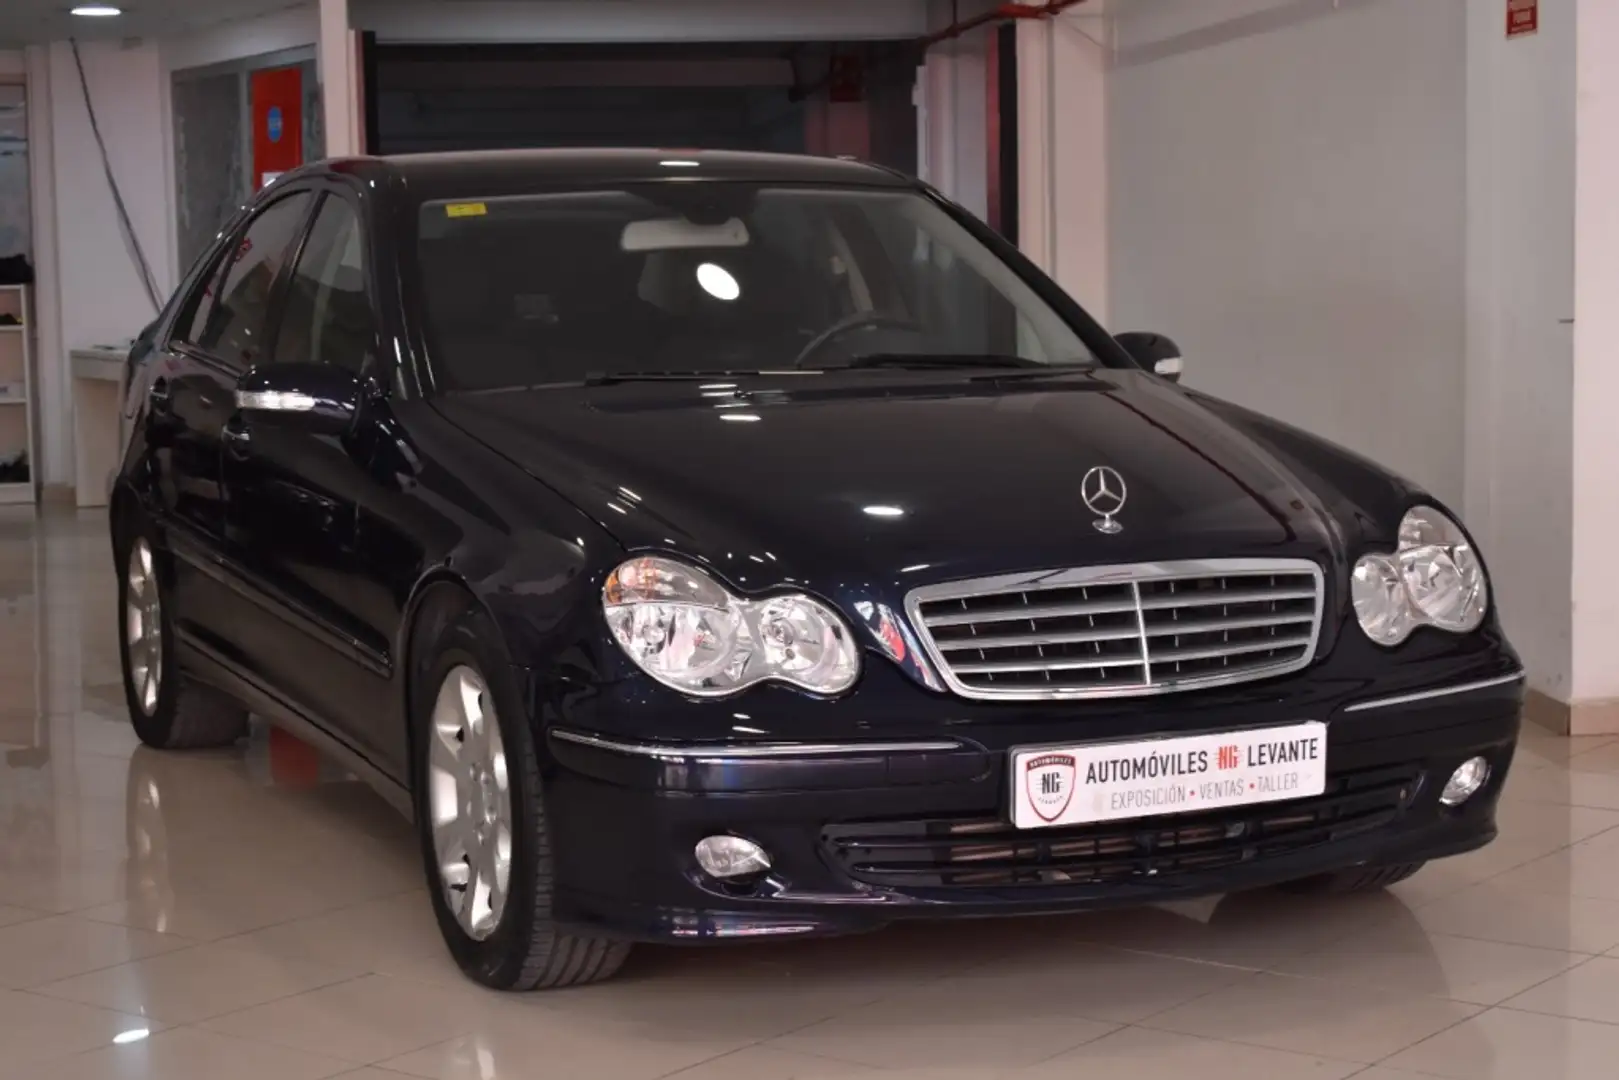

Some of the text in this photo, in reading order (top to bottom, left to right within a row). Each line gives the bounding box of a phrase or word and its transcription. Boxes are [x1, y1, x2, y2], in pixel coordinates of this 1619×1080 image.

[1085, 749, 1208, 785] AUTOMÓVILES
[1247, 737, 1319, 767] LEVANTE
[1041, 772, 1061, 794] NG
[1111, 772, 1298, 810] EXPOSICIÓN VENTAS TALLER
